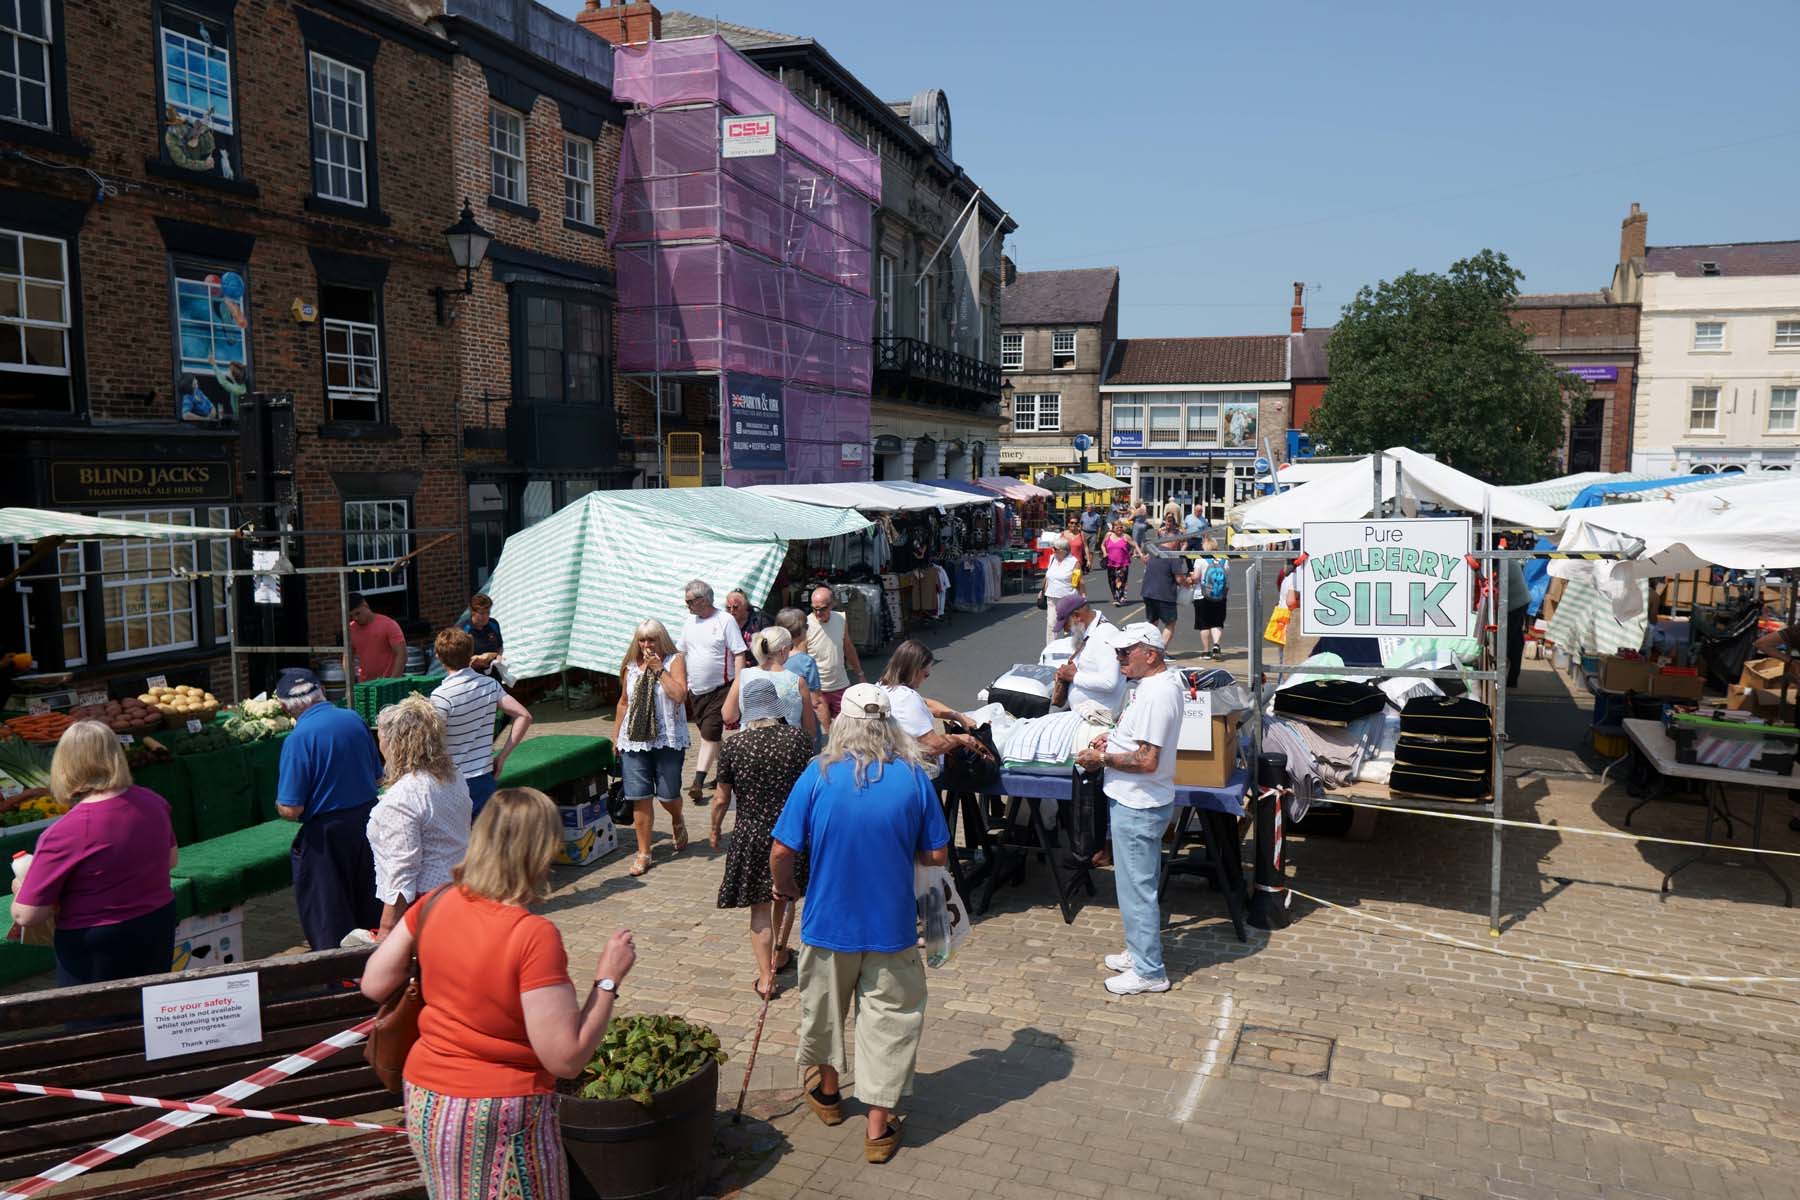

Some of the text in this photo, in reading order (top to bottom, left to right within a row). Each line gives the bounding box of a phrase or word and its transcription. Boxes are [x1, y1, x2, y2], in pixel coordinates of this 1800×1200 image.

[1000, 452, 1024, 460] mery
[79, 466, 209, 486] BLIND JACK'S
[88, 488, 151, 497] TRADITIONAL
[174, 486, 203, 494] HOUSE
[1365, 526, 1403, 543] Pure
[1310, 547, 1461, 581] MULBERRY
[1313, 581, 1457, 628] SILK
[155, 1015, 170, 1023] This
[172, 1012, 188, 1021] seat
[210, 1005, 242, 1014] available
[161, 997, 235, 1014] For your safety.
[157, 1012, 241, 1030] whilst queuing systems
[193, 1022, 227, 1034] progress.
[181, 1040, 202, 1048] Thank
